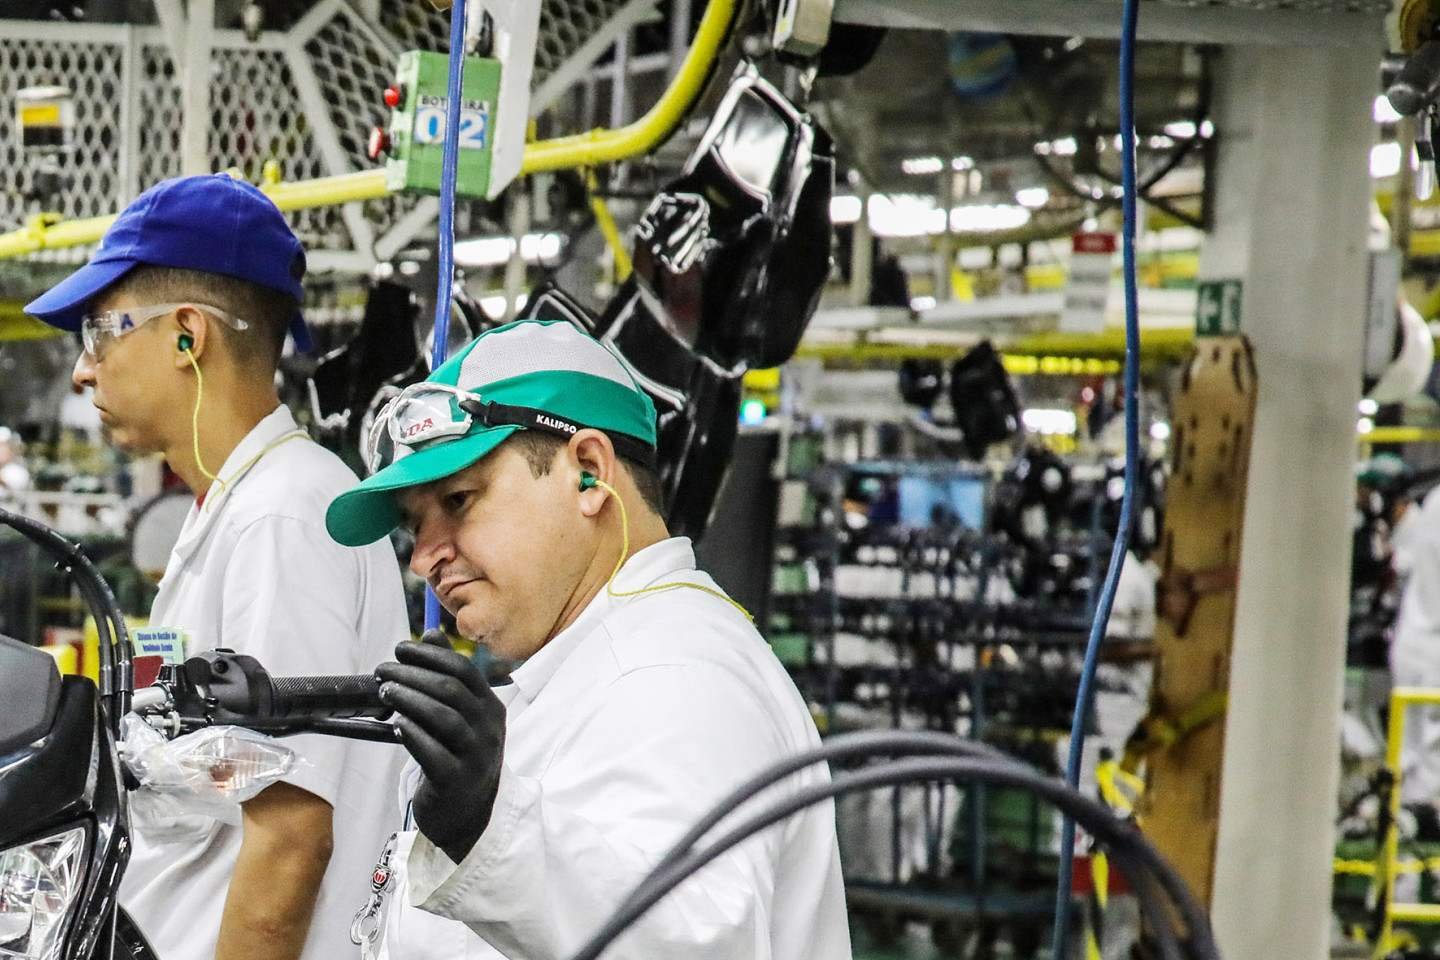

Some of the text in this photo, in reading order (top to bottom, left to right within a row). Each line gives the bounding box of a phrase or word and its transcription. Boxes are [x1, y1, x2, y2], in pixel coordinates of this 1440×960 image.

[422, 95, 484, 111] BOTIRA
[416, 107, 483, 149] 02
[536, 414, 577, 434] KALIPSO
